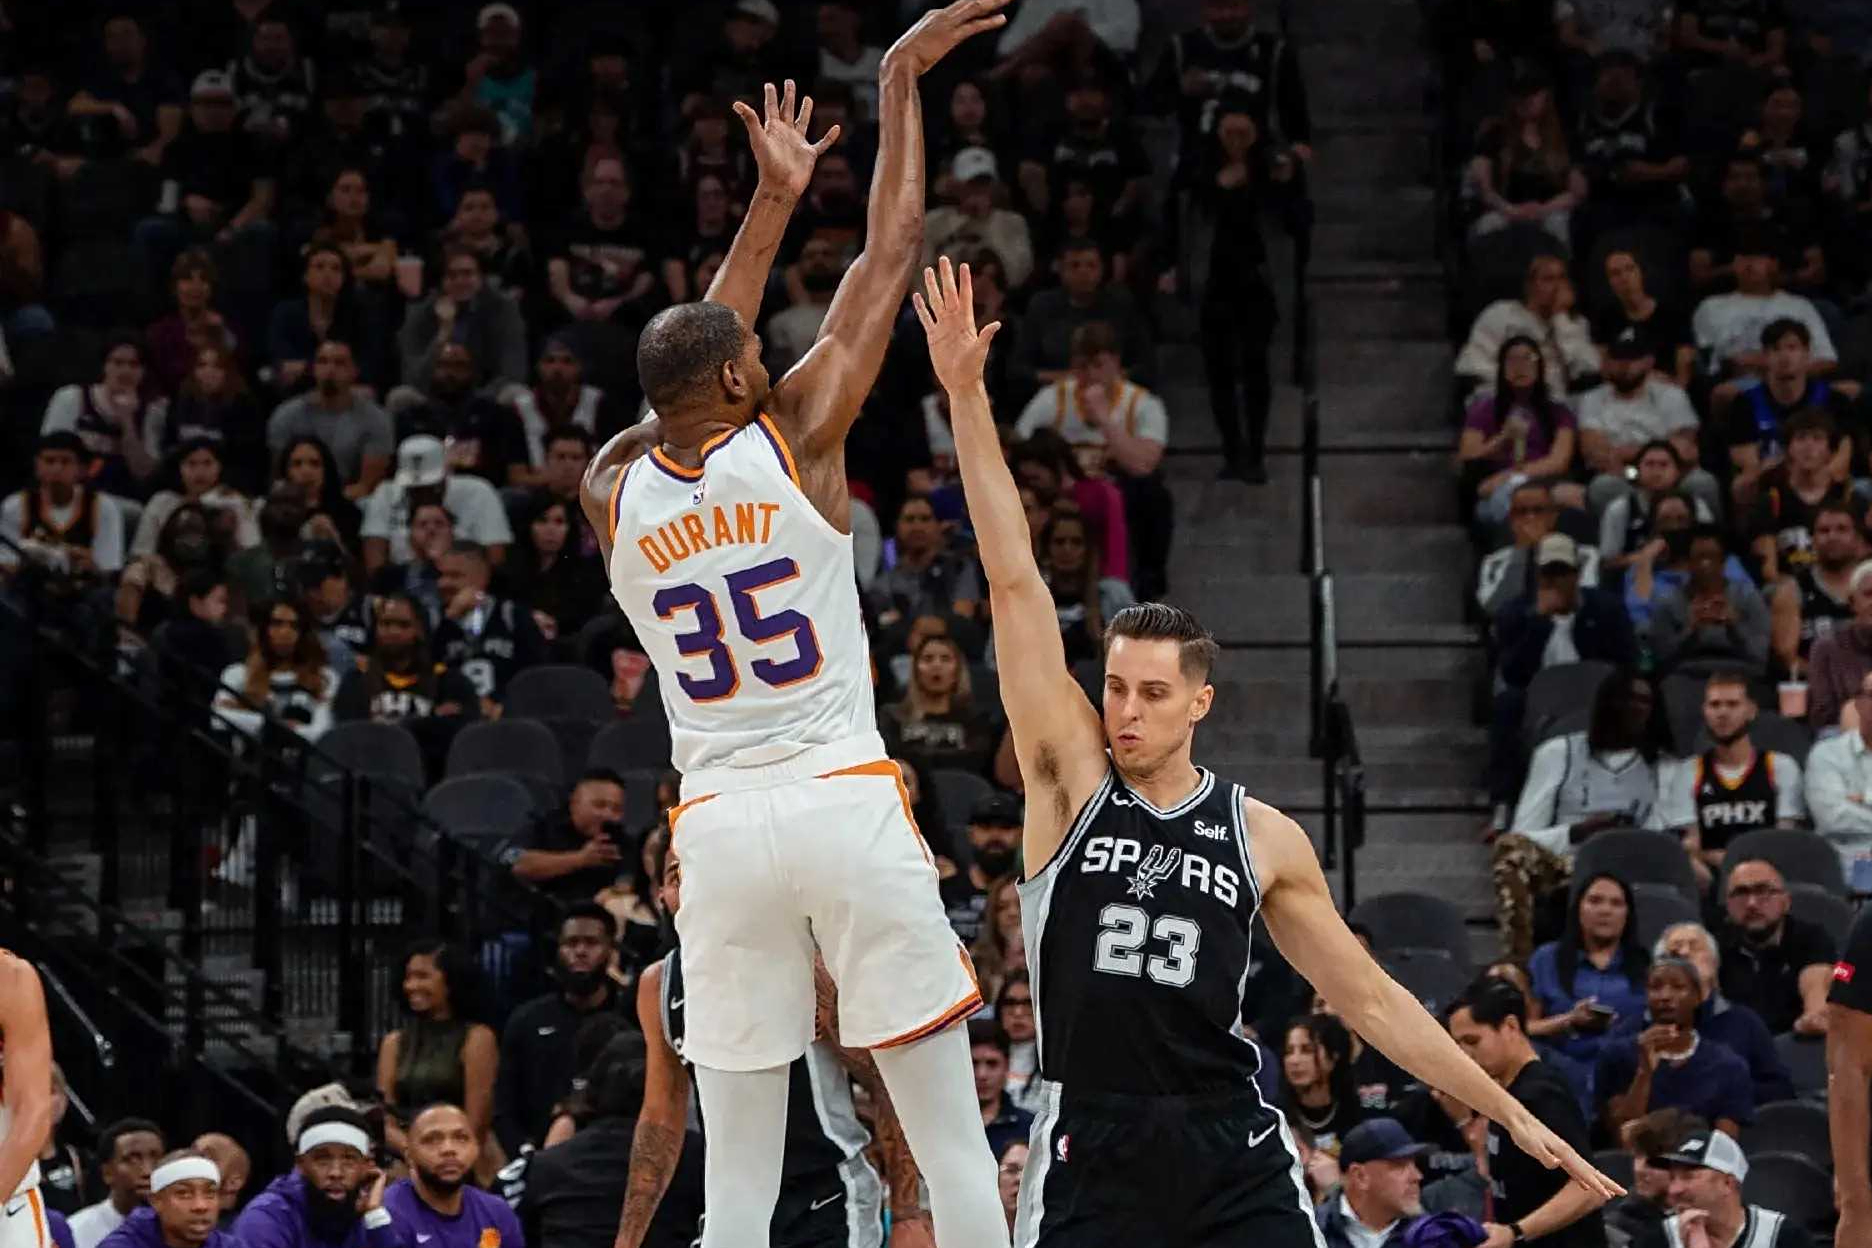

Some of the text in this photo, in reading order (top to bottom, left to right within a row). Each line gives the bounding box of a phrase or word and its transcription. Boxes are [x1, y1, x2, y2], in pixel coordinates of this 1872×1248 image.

[637, 502, 780, 574] DURANT
[652, 556, 825, 704] 35
[1193, 820, 1229, 841] Self.
[1702, 800, 1767, 829] PHX
[1080, 836, 1240, 909] SPURS
[1093, 902, 1202, 989] 23
